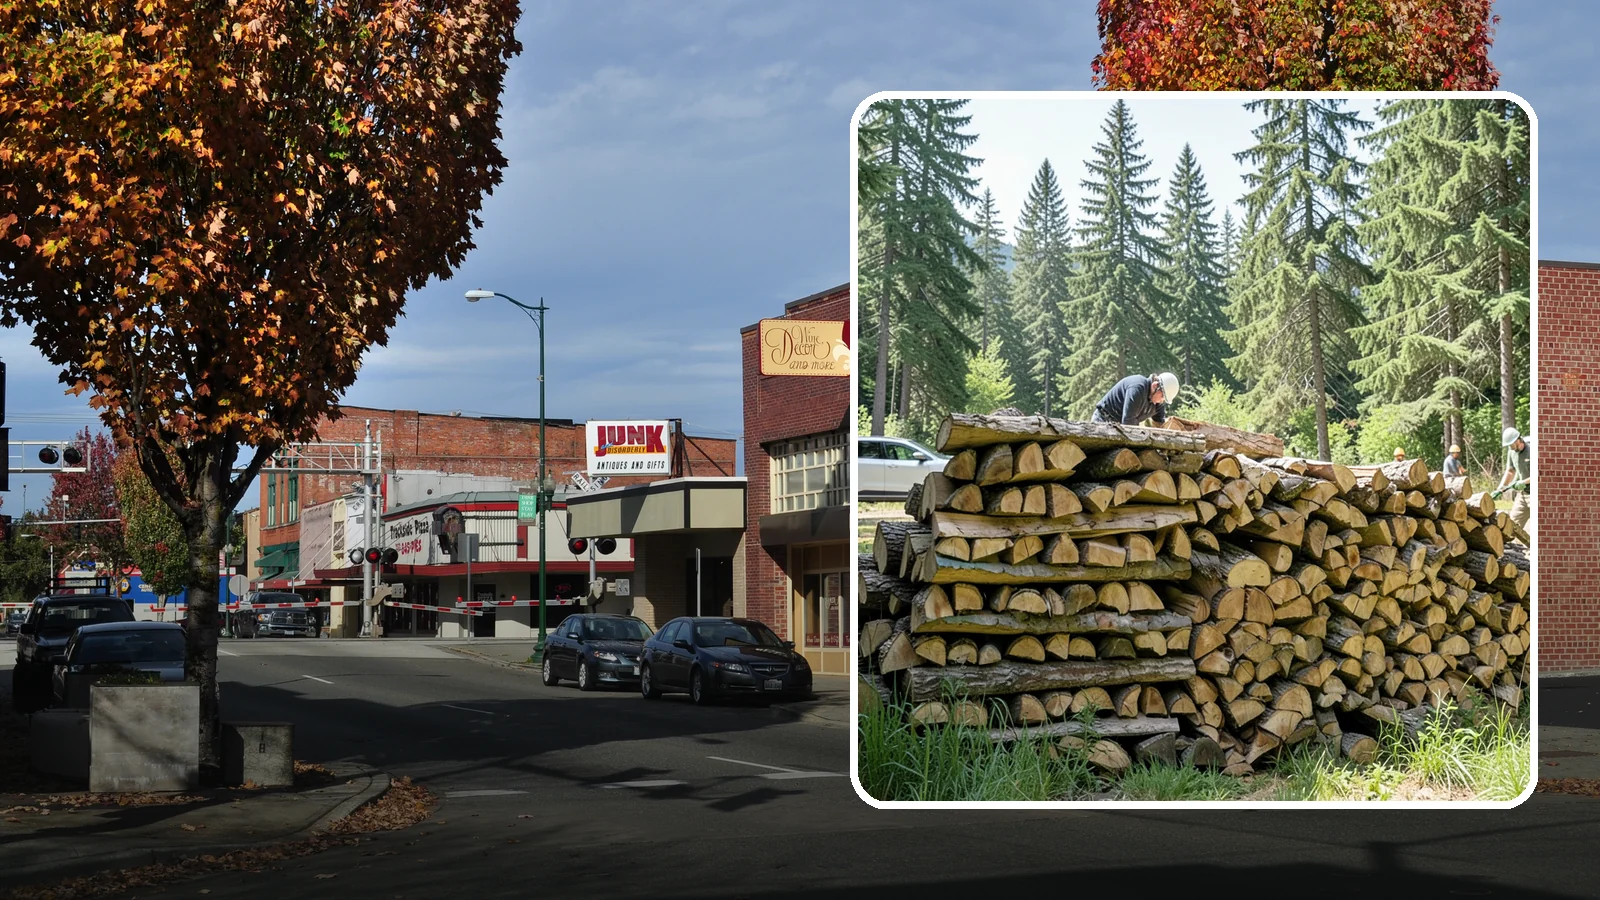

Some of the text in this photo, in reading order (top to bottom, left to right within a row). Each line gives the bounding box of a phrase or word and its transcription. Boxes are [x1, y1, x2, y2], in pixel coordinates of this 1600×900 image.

[765, 327, 831, 365] Decor
[595, 425, 665, 457] JUNK
[607, 446, 645, 454] DISORDERLY
[596, 461, 665, 470] ANTIQUES AND GIFTS
[414, 519, 429, 535] Pizza
